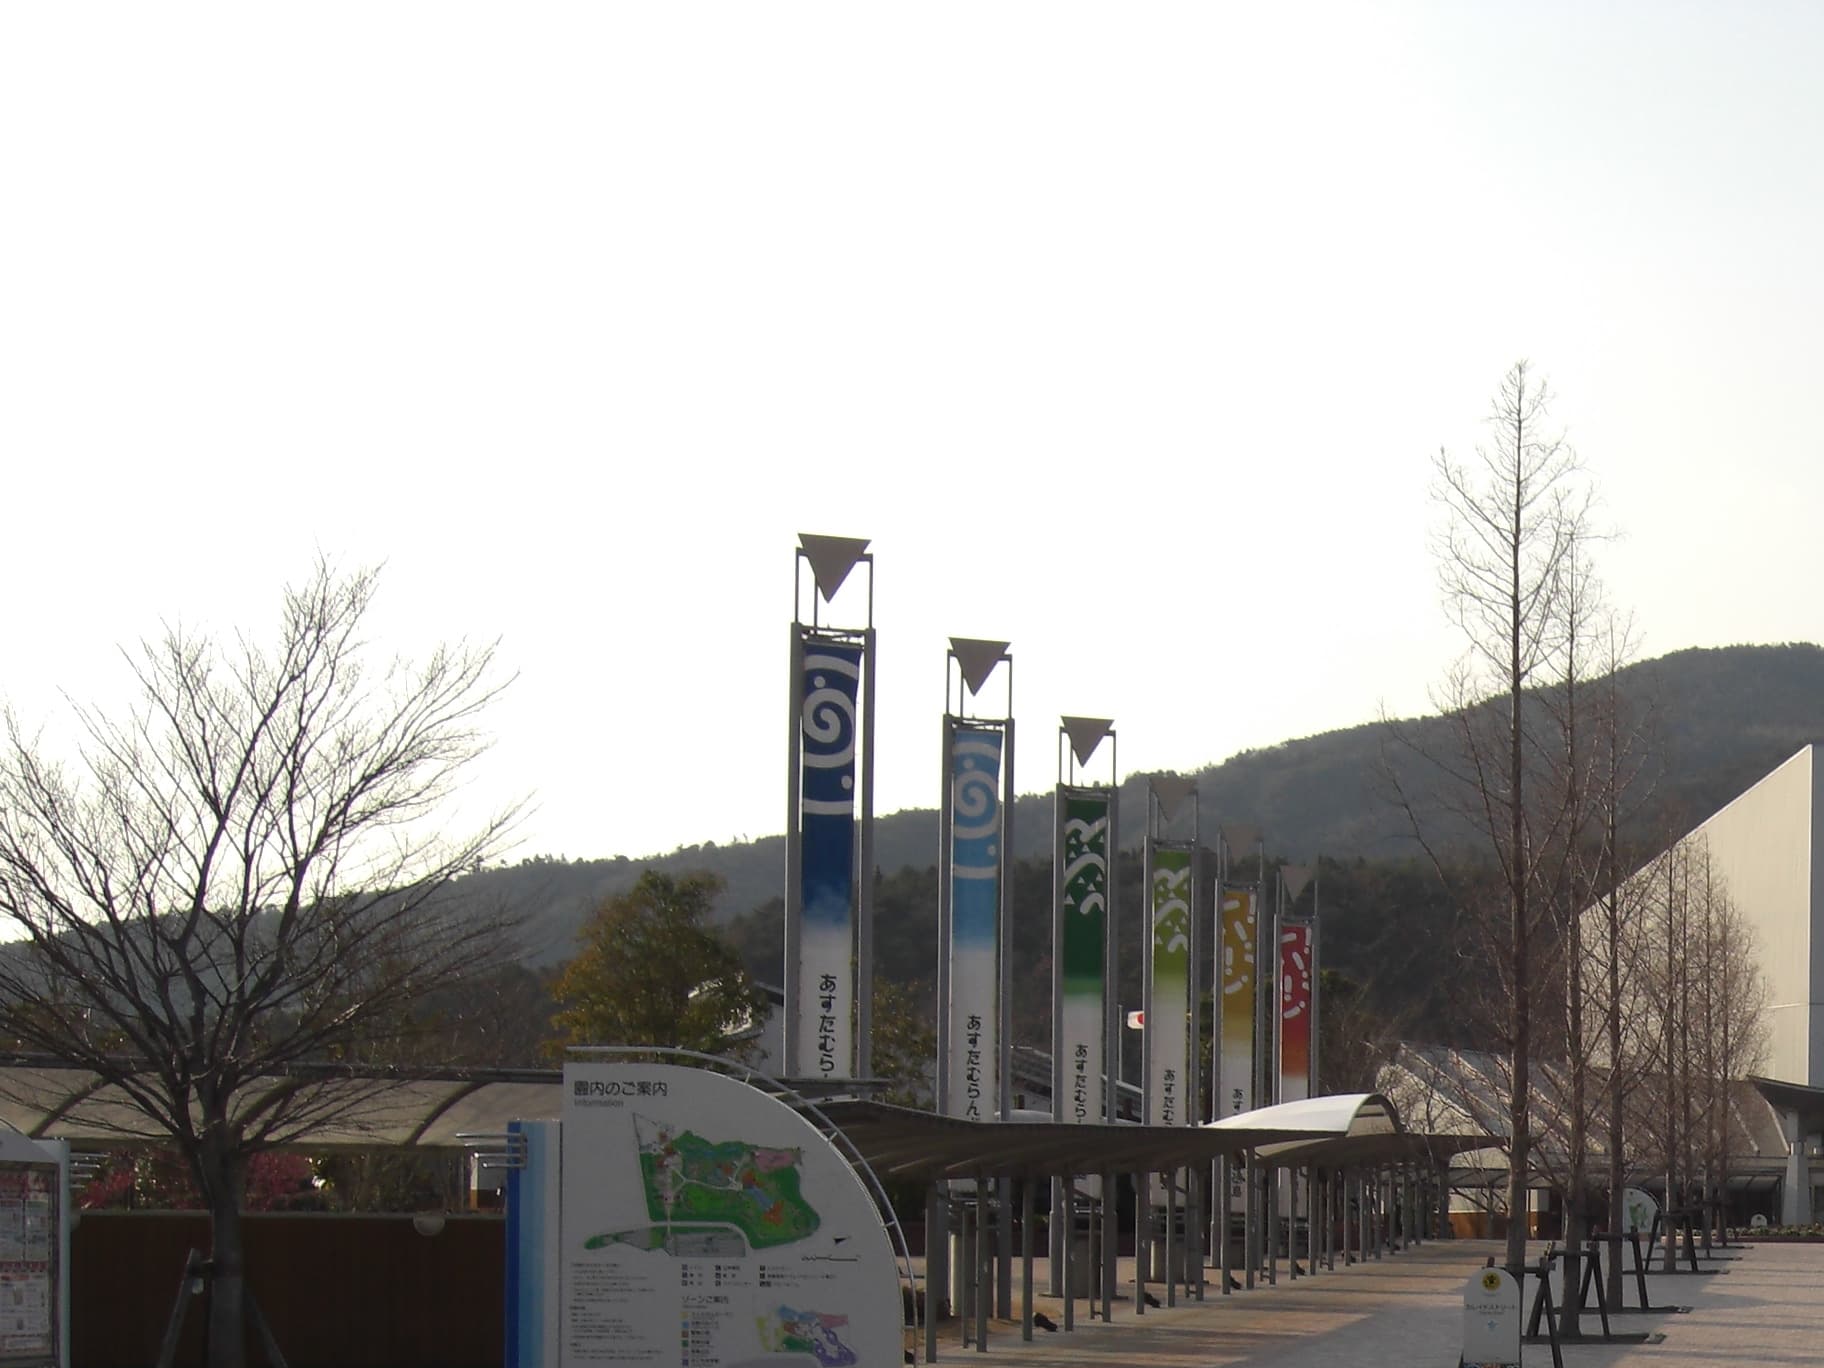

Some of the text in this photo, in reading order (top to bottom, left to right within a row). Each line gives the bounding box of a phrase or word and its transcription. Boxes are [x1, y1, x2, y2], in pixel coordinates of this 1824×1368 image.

[819, 974, 837, 1078] あすたむら
[966, 1015, 981, 1121] あすたむらん
[1074, 1044, 1088, 1123] あすたむら
[1162, 1069, 1175, 1125] あすたむ
[1232, 1088, 1243, 1115] あす
